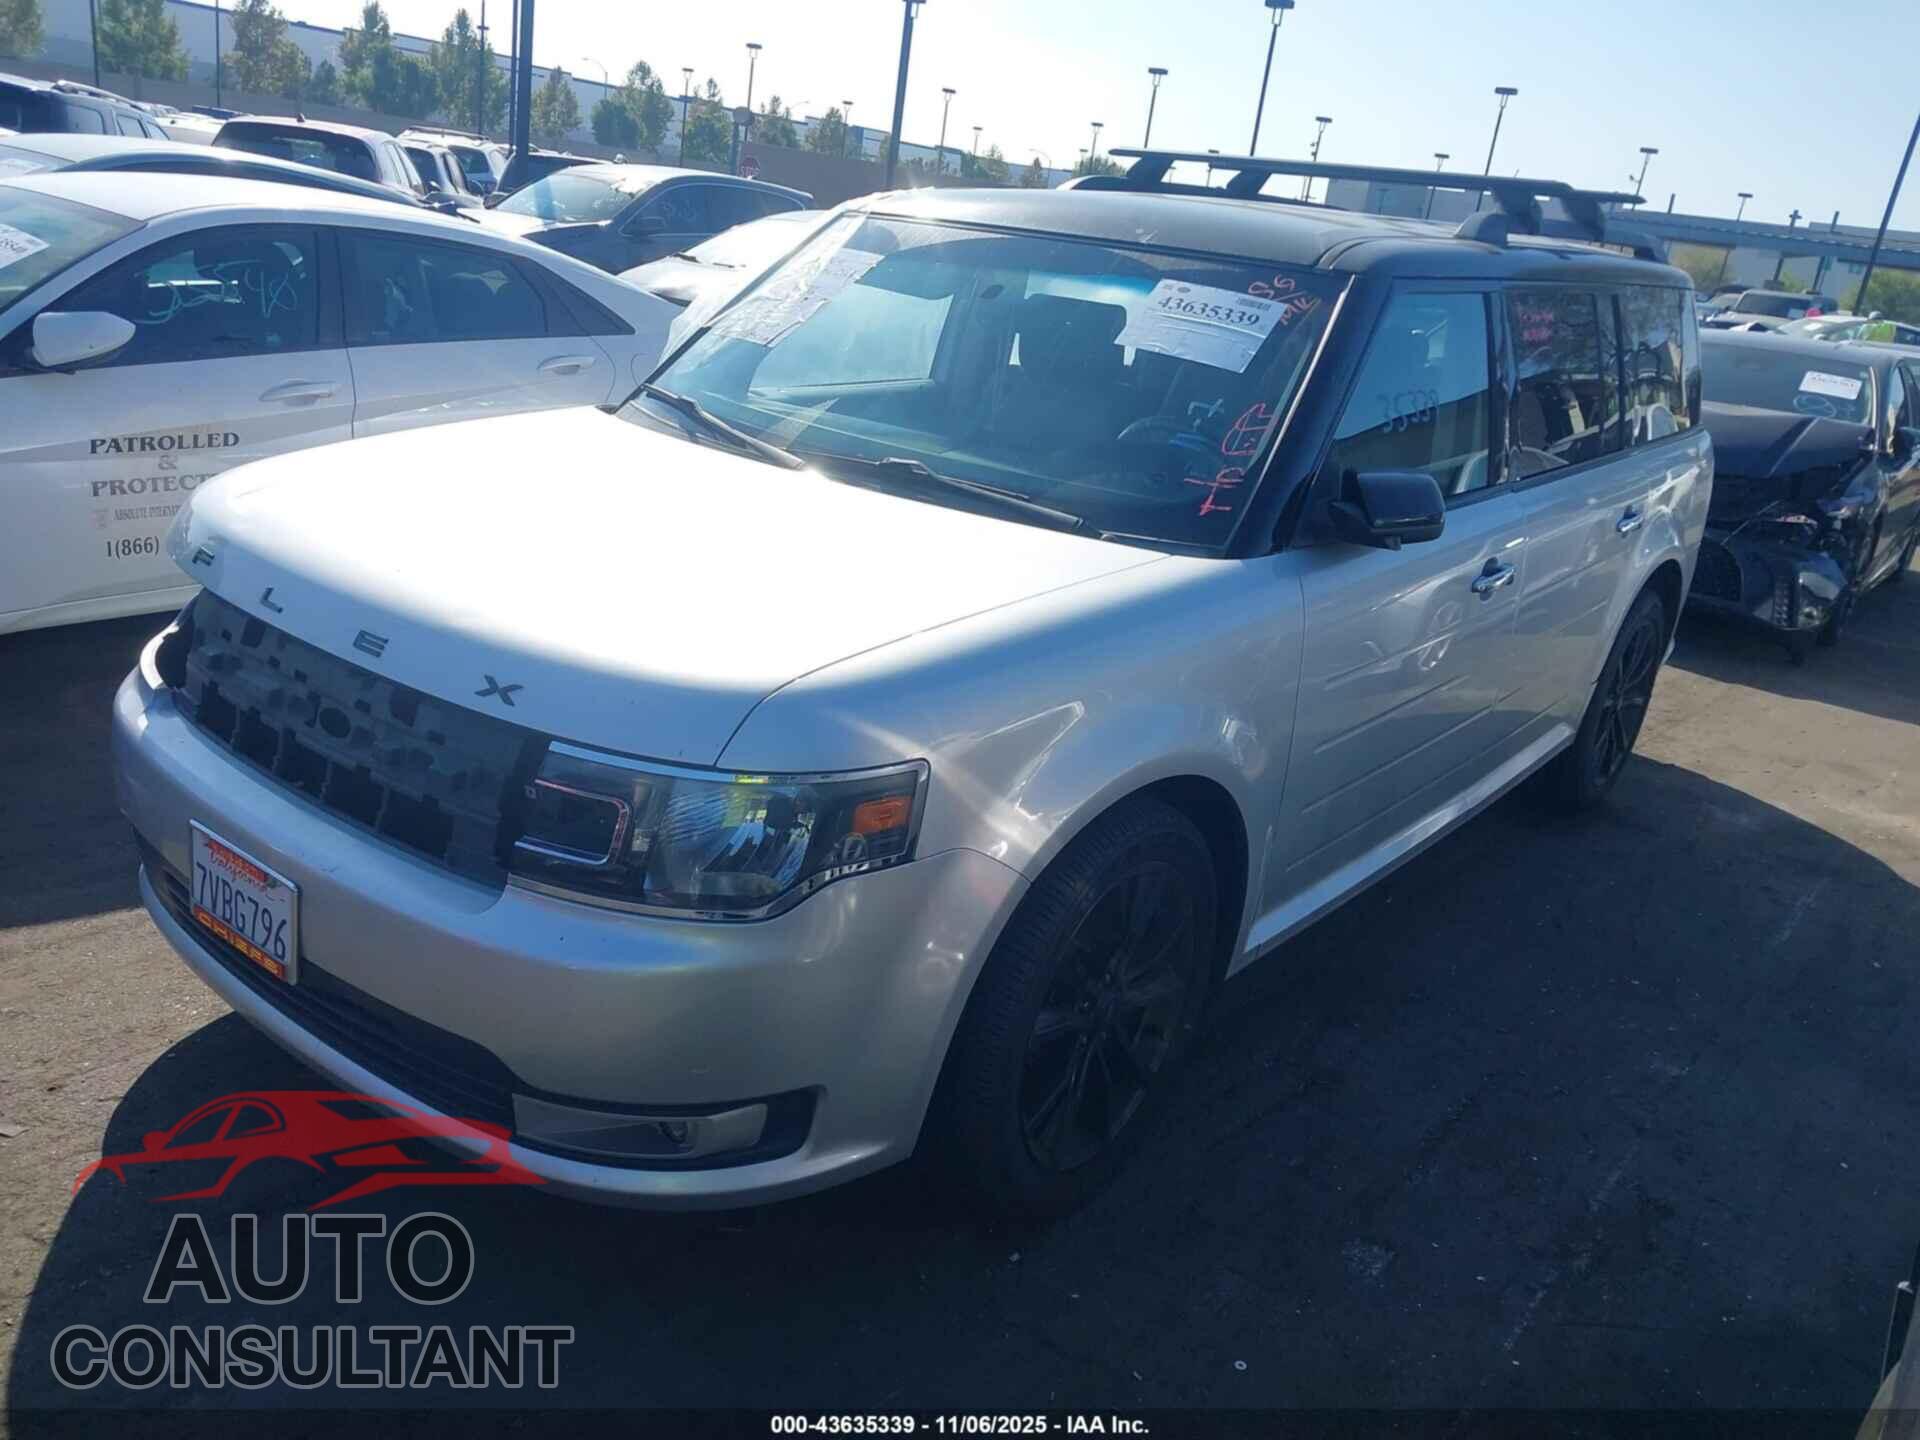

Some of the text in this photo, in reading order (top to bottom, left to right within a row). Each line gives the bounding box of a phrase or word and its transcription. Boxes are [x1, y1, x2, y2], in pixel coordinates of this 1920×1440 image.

[1157, 296, 1261, 327] 43635339
[89, 432, 240, 454] PATROLLED
[157, 455, 178, 470] &
[91, 472, 219, 497] PROTECT
[106, 536, 160, 559] 1(866)
[196, 861, 287, 962] 7VBG796
